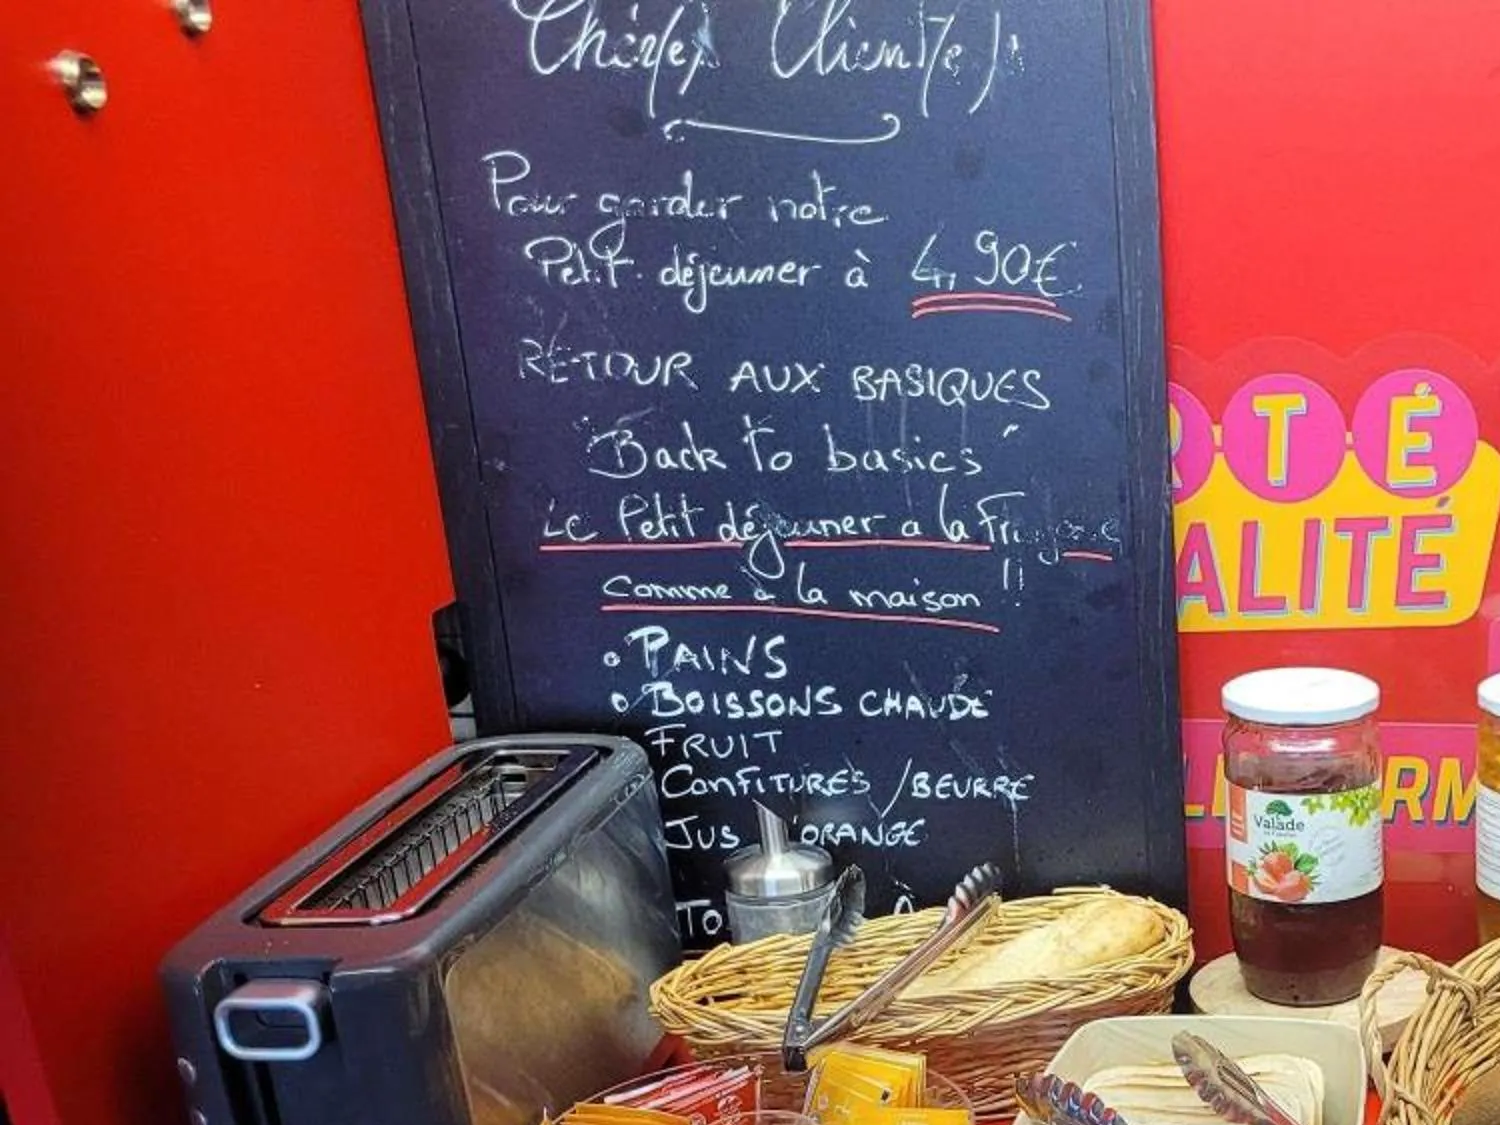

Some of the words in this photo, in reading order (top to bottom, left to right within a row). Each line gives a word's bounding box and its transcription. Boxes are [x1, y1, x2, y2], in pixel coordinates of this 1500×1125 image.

[844, 249, 872, 288] à
[729, 360, 826, 393] AUX
[852, 363, 1051, 410] BASIQUES
[618, 492, 705, 542] Petit
[938, 483, 971, 543] la
[797, 561, 828, 605] la
[849, 577, 981, 613] maison
[642, 681, 843, 719] BOISSONS
[645, 722, 784, 760] FRUIT
[665, 814, 741, 850] JUS
[1252, 813, 1305, 833] Valade
